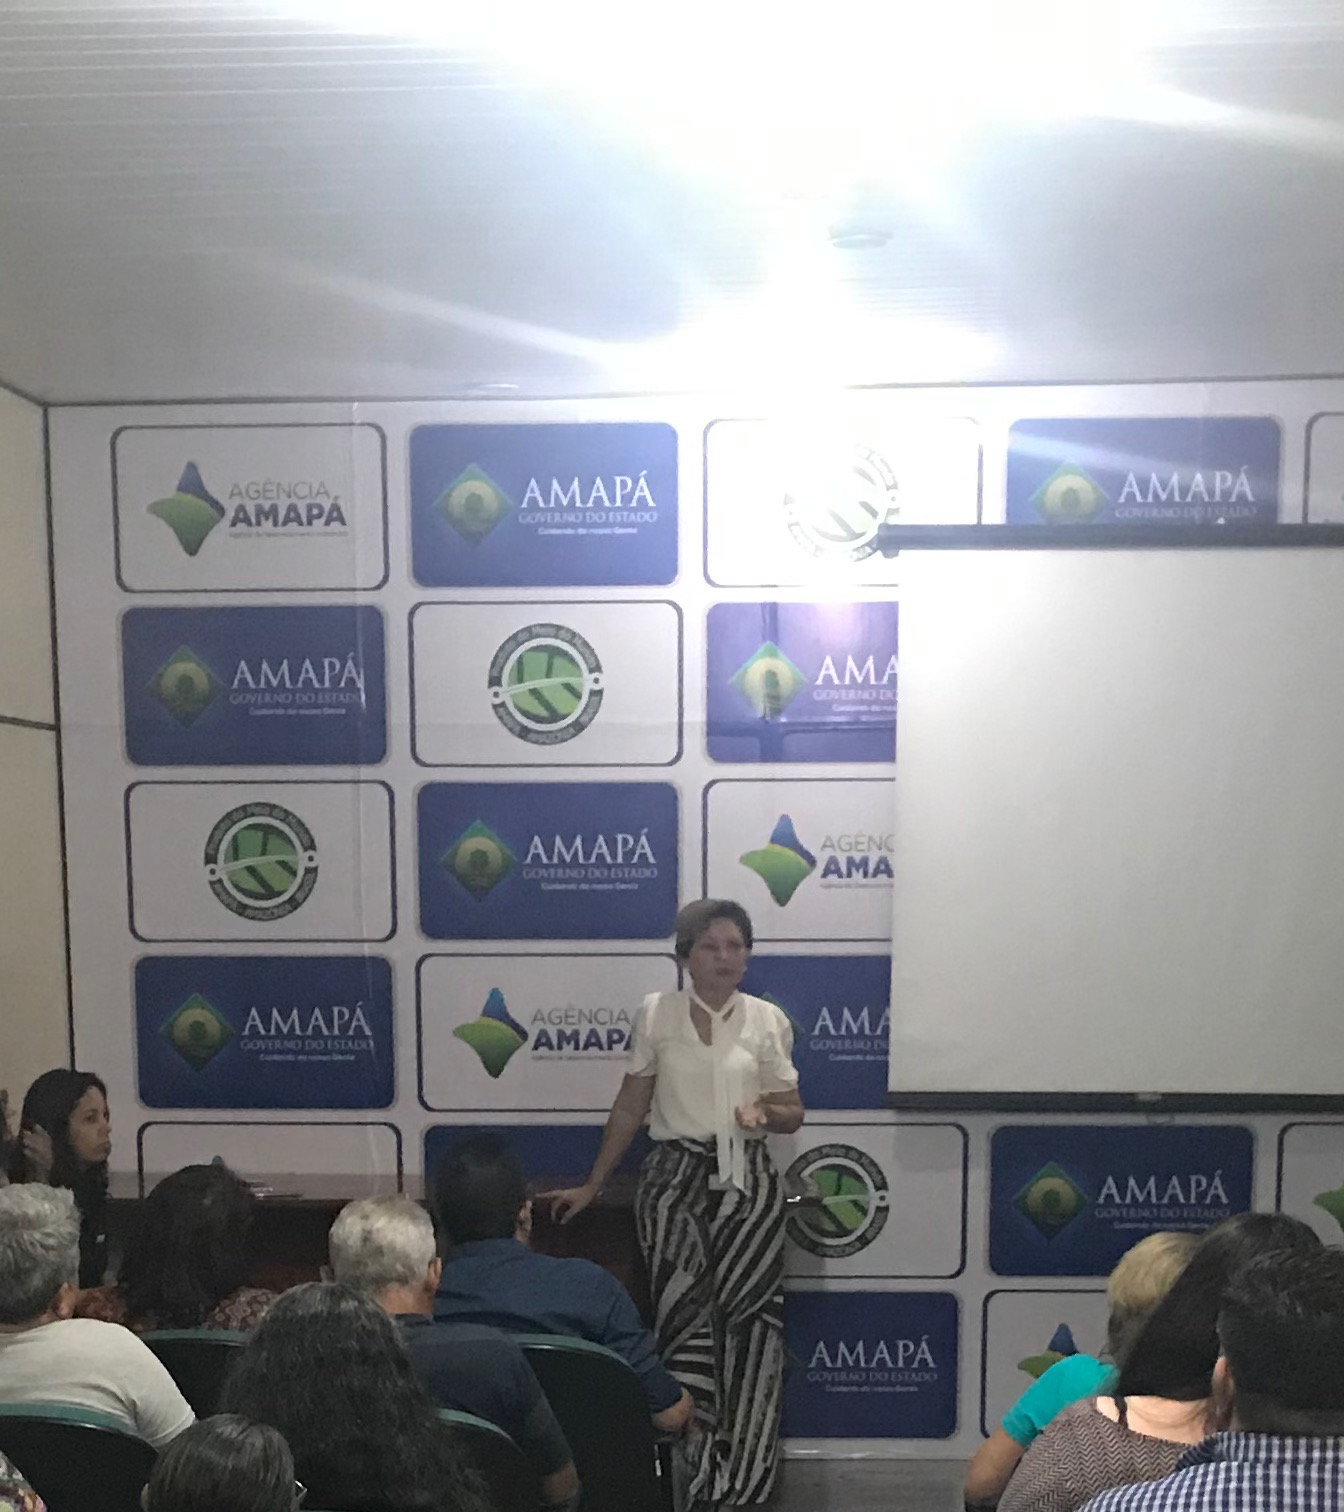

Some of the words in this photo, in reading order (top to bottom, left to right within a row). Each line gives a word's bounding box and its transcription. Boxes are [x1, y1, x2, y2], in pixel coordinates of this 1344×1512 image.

[229, 478, 331, 501] AGÊNCIA
[520, 470, 656, 508] AMAPÁ
[1118, 464, 1256, 503] AMAPÁ
[229, 496, 347, 528] AMAPÁ
[518, 511, 582, 523] GOVERNO
[585, 511, 606, 523] DO
[609, 511, 658, 523] ESTADO
[231, 651, 362, 689] AMAPÁ
[815, 655, 897, 685] AMA
[296, 692, 315, 704] DO
[523, 828, 656, 864] AMAPÁ
[820, 830, 895, 853] AGÊNC
[522, 867, 585, 879] GOVERNO
[587, 867, 608, 879] DO
[611, 867, 658, 879] ESTADO
[820, 855, 895, 879] AMA
[241, 1001, 373, 1036] AMAPÁ
[531, 1001, 631, 1026] AGÊNCIA
[811, 1006, 890, 1036] AMA
[240, 1039, 303, 1051] GOVERNO
[305, 1039, 325, 1051] DO
[1097, 1169, 1229, 1204] AMAPÁ
[1162, 1207, 1181, 1219] DO
[808, 1334, 936, 1368] AMAPÁ
[870, 1371, 888, 1382] DO
[891, 1371, 938, 1382] ESTADO
